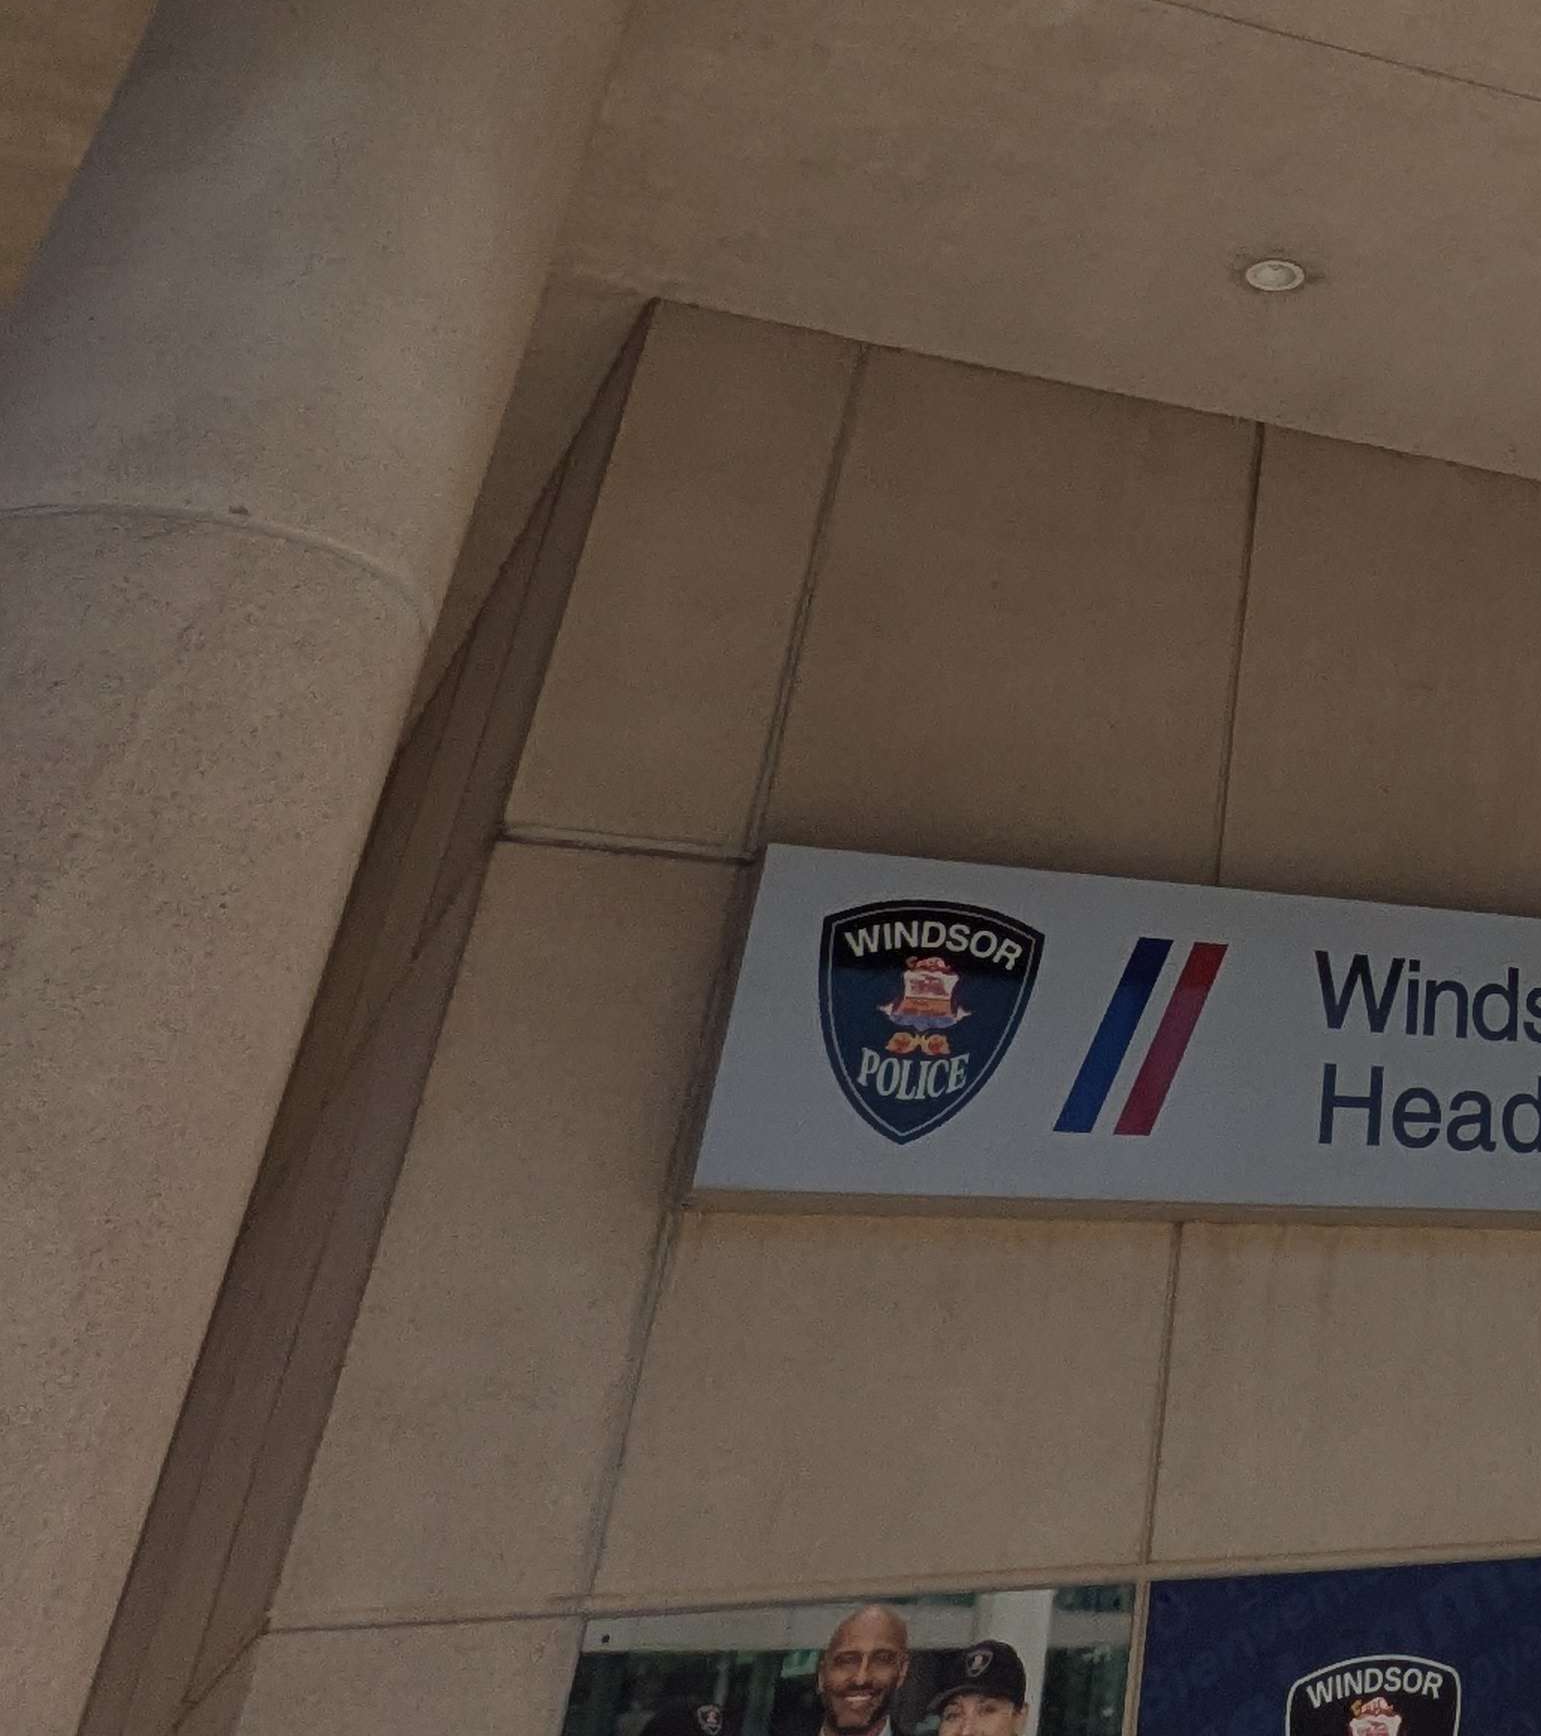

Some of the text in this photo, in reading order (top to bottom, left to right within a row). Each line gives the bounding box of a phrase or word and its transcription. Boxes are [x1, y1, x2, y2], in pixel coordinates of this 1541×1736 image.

[844, 920, 1023, 970] WINDSOR
[856, 1047, 969, 1101] POLICE
[1305, 1666, 1444, 1709] WINDSOR
